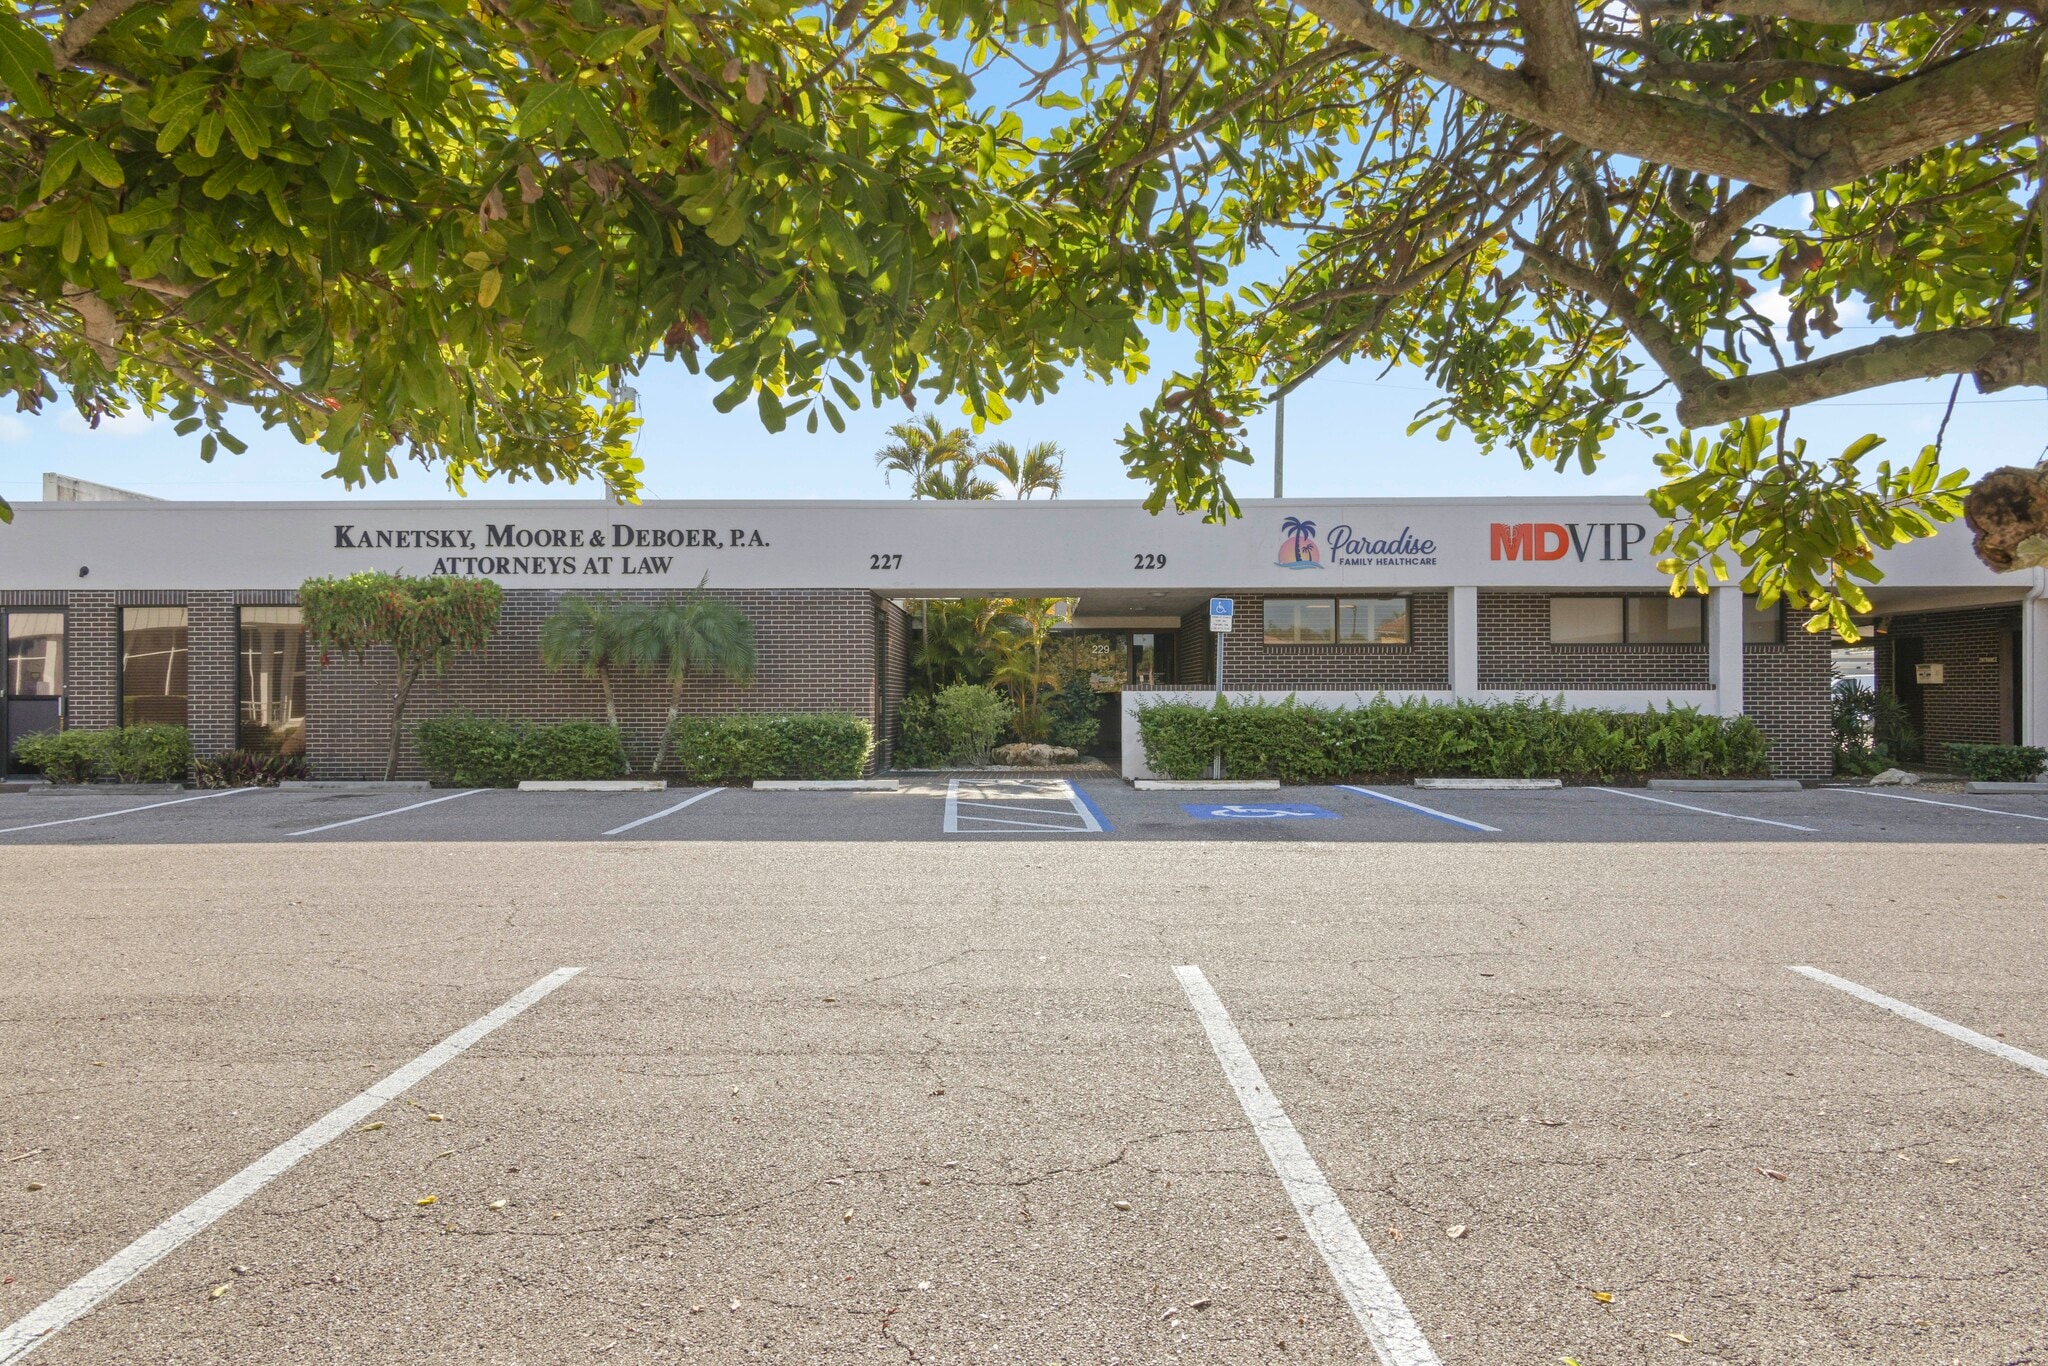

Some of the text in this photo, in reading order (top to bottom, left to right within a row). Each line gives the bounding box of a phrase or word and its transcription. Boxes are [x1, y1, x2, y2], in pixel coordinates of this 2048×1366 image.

[334, 524, 770, 550] KANETSKY, MOORE & DEBOER, P.A.
[1327, 524, 1437, 563] Paradise
[1490, 522, 1646, 562] MDVIP
[432, 556, 674, 575] ATTORNEYS AT LAW
[870, 554, 902, 570] 227
[1134, 554, 1167, 570] 229
[1339, 557, 1437, 566] FAMILY HEALTHCARE
[1091, 644, 1110, 654] 229
